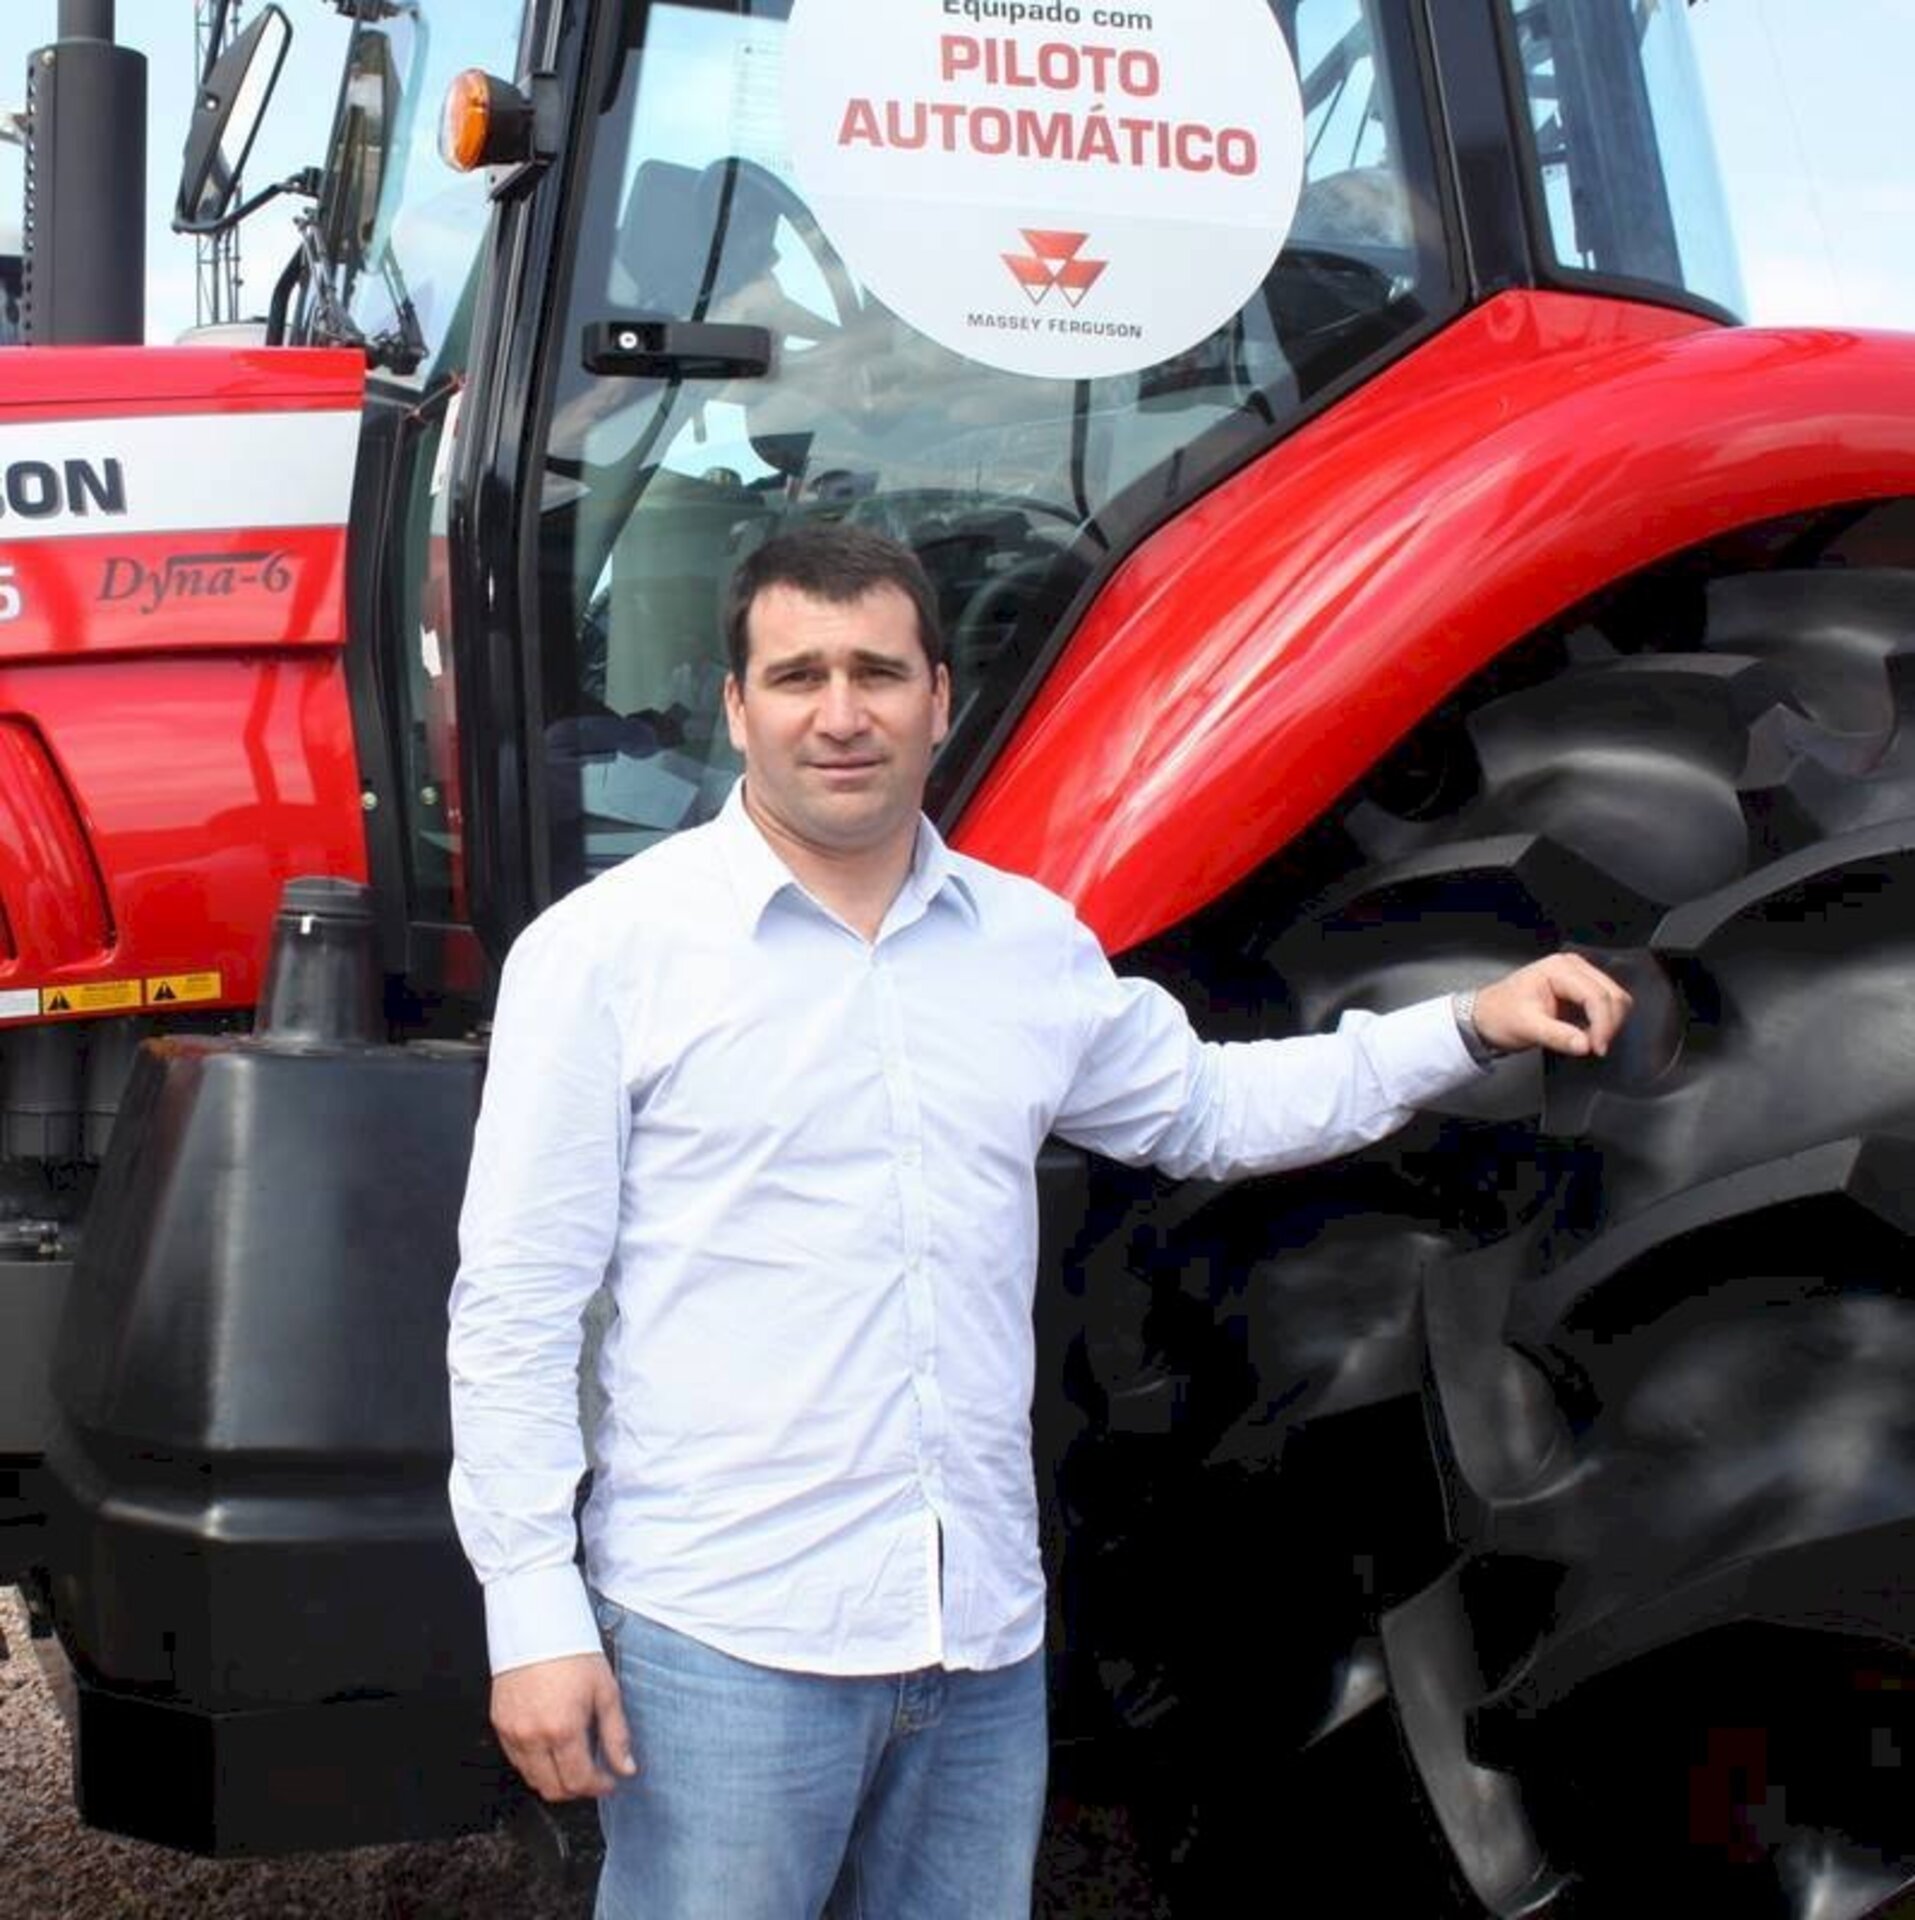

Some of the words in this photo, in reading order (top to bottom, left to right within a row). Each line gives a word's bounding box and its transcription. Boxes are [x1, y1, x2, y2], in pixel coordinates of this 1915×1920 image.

[942, 0, 1081, 25] Equipado
[1093, 8, 1153, 30] com
[940, 35, 1160, 96] PILOTO
[838, 98, 1257, 176] AUTOMÁTICO
[967, 314, 1041, 331] MASSEY
[1049, 318, 1143, 338] FERGUSON
[0, 458, 127, 519] ON
[97, 551, 293, 615] Dyna-6
